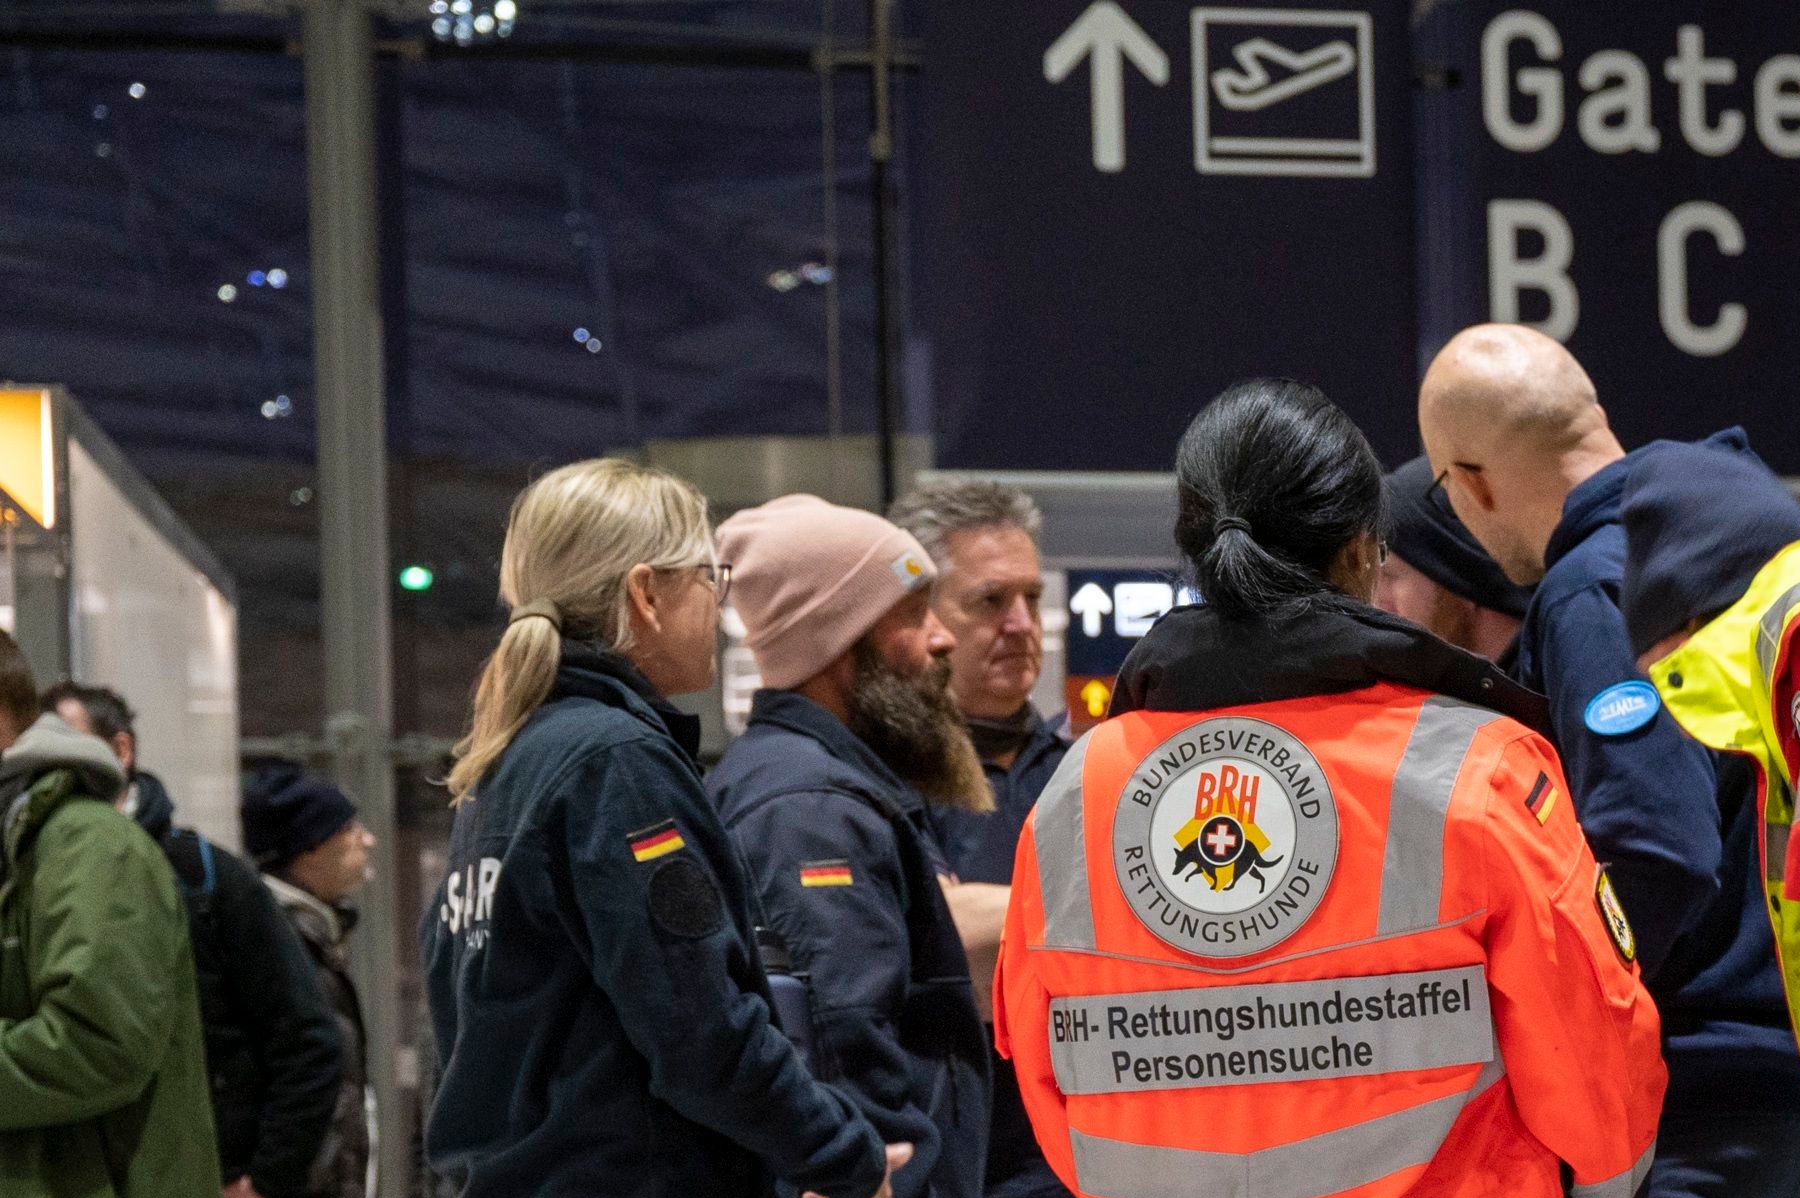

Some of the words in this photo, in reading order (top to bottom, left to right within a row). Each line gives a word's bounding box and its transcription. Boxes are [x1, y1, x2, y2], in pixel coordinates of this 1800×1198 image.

[1488, 199, 1580, 344] B
[1657, 200, 1748, 357] C
[1132, 730, 1321, 819] BUNDESVERBAND
[1194, 764, 1260, 825] BRH
[1124, 845, 1319, 943] RETTUNGSHUNDE
[1108, 979, 1471, 1040] Rettungshundestaffel
[1112, 1036, 1373, 1083] Personensuche
